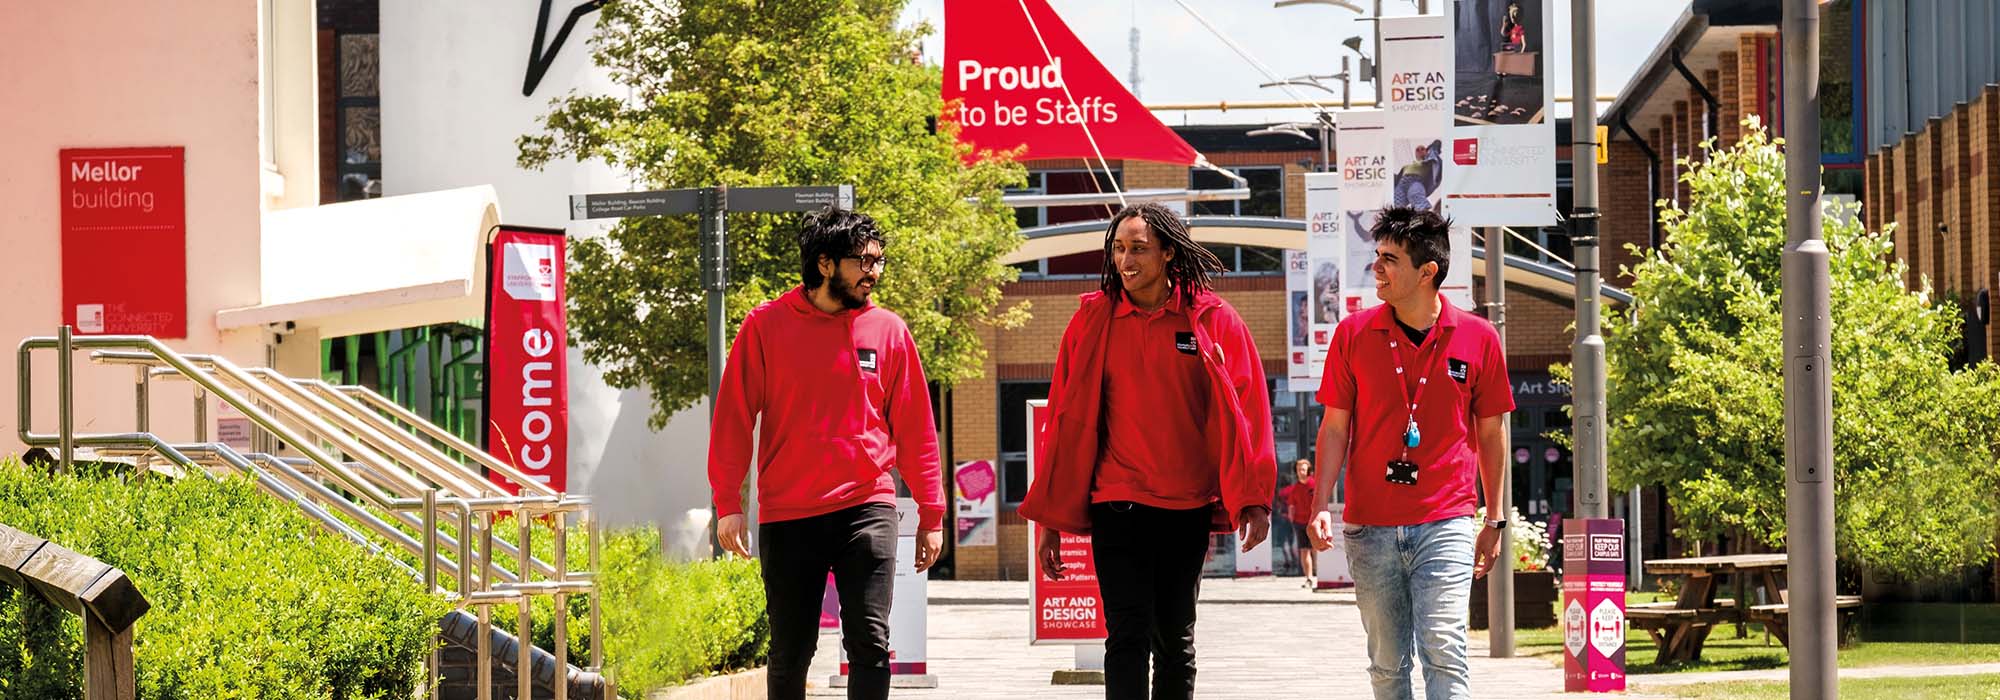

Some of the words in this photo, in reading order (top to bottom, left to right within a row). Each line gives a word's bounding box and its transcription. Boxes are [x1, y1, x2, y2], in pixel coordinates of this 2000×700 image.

[959, 56, 1062, 91] Proud
[1391, 72, 1420, 85] ART
[1425, 71, 1445, 84] AN
[1391, 86, 1445, 102] DESIG
[960, 101, 986, 127] to
[994, 100, 1028, 126] be
[1035, 96, 1118, 125] Staffs
[1344, 156, 1369, 166] ART
[71, 161, 142, 182] Mellor
[1344, 167, 1386, 180] DESIG
[72, 187, 154, 212] building
[1312, 222, 1340, 233] DESI
[1519, 381, 1543, 394] Art
[1060, 535, 1075, 544] trial
[1594, 543, 1607, 551] KEEP
[1608, 543, 1619, 551] OUR
[1043, 597, 1067, 608] ART
[1069, 597, 1096, 608] AND
[1043, 608, 1097, 620] DESIGN
[1043, 620, 1097, 629] SHOWCASE
